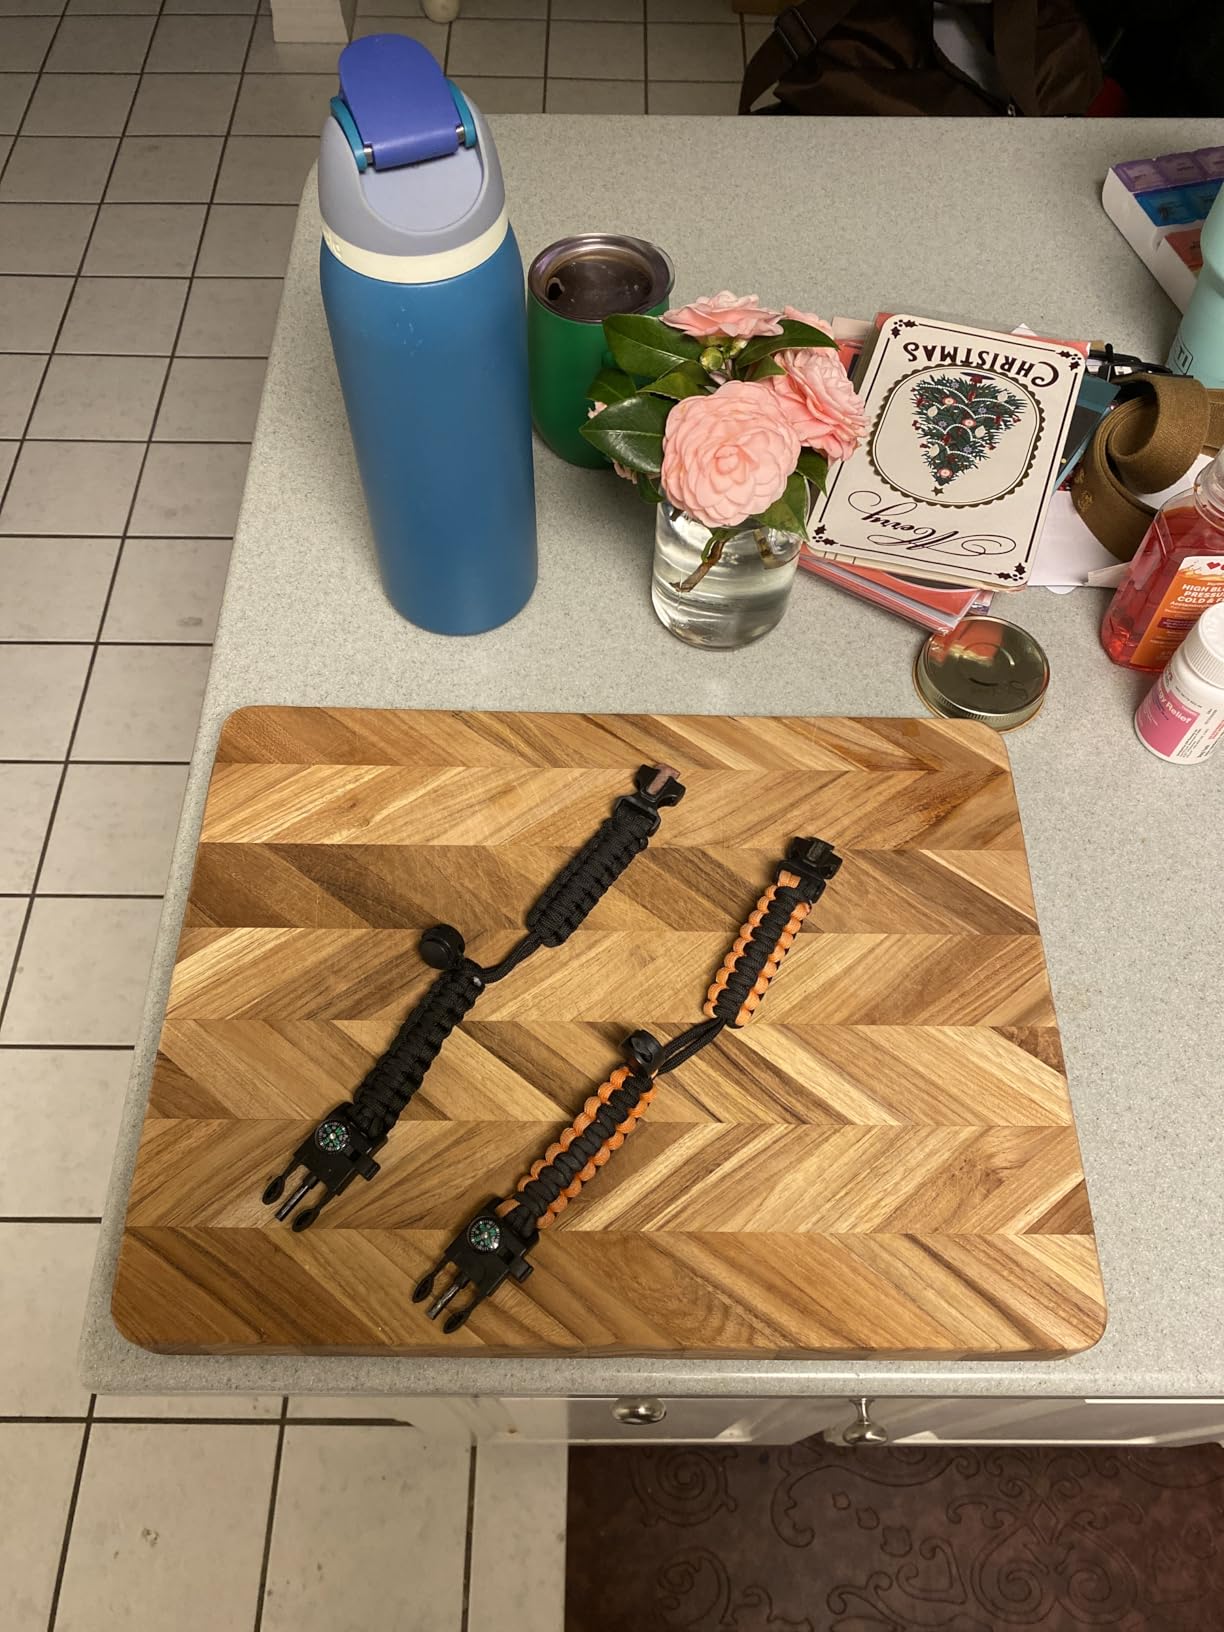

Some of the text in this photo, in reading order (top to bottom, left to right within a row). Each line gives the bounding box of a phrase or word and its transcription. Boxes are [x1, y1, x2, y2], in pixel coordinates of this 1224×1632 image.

[902, 341, 1060, 389] CHRISTMAS
[847, 490, 1017, 557] Merry
[1181, 583, 1210, 593] HIGH
[1177, 596, 1206, 604] COLD
[1165, 702, 1192, 724] Relief
